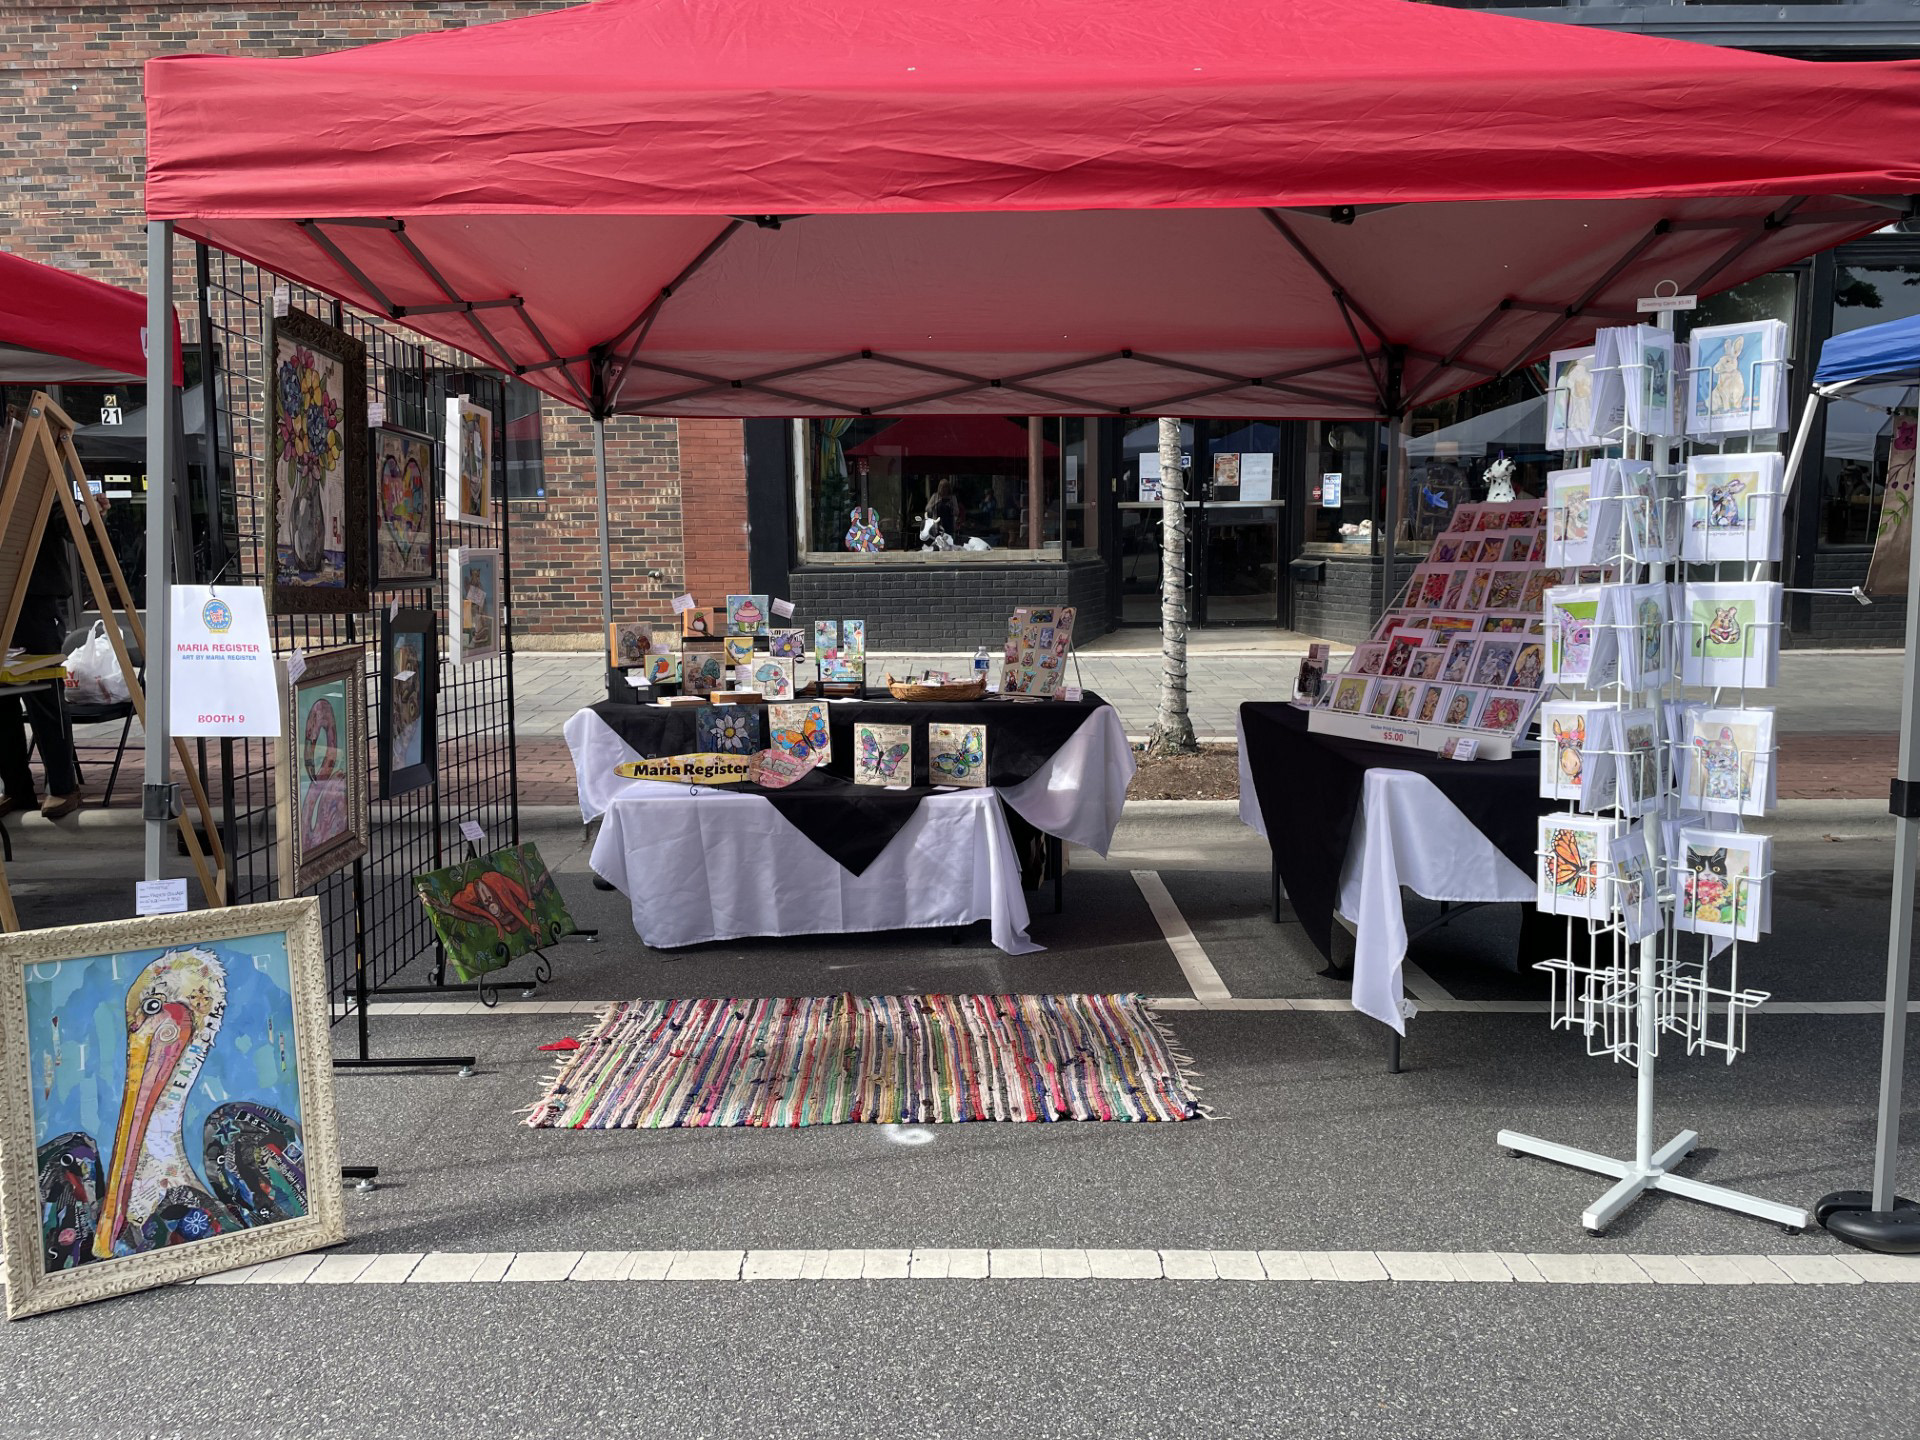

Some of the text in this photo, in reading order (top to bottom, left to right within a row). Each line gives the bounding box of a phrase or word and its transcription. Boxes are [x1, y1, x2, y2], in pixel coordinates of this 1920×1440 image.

[105, 395, 117, 406] 21
[103, 409, 119, 424] 21
[177, 643, 260, 653] MARIA REGISTER
[198, 714, 245, 723] BOOTH 9
[1384, 732, 1403, 742] $5.00
[634, 763, 750, 778] Maria Register
[168, 1043, 203, 1101] BEACH
